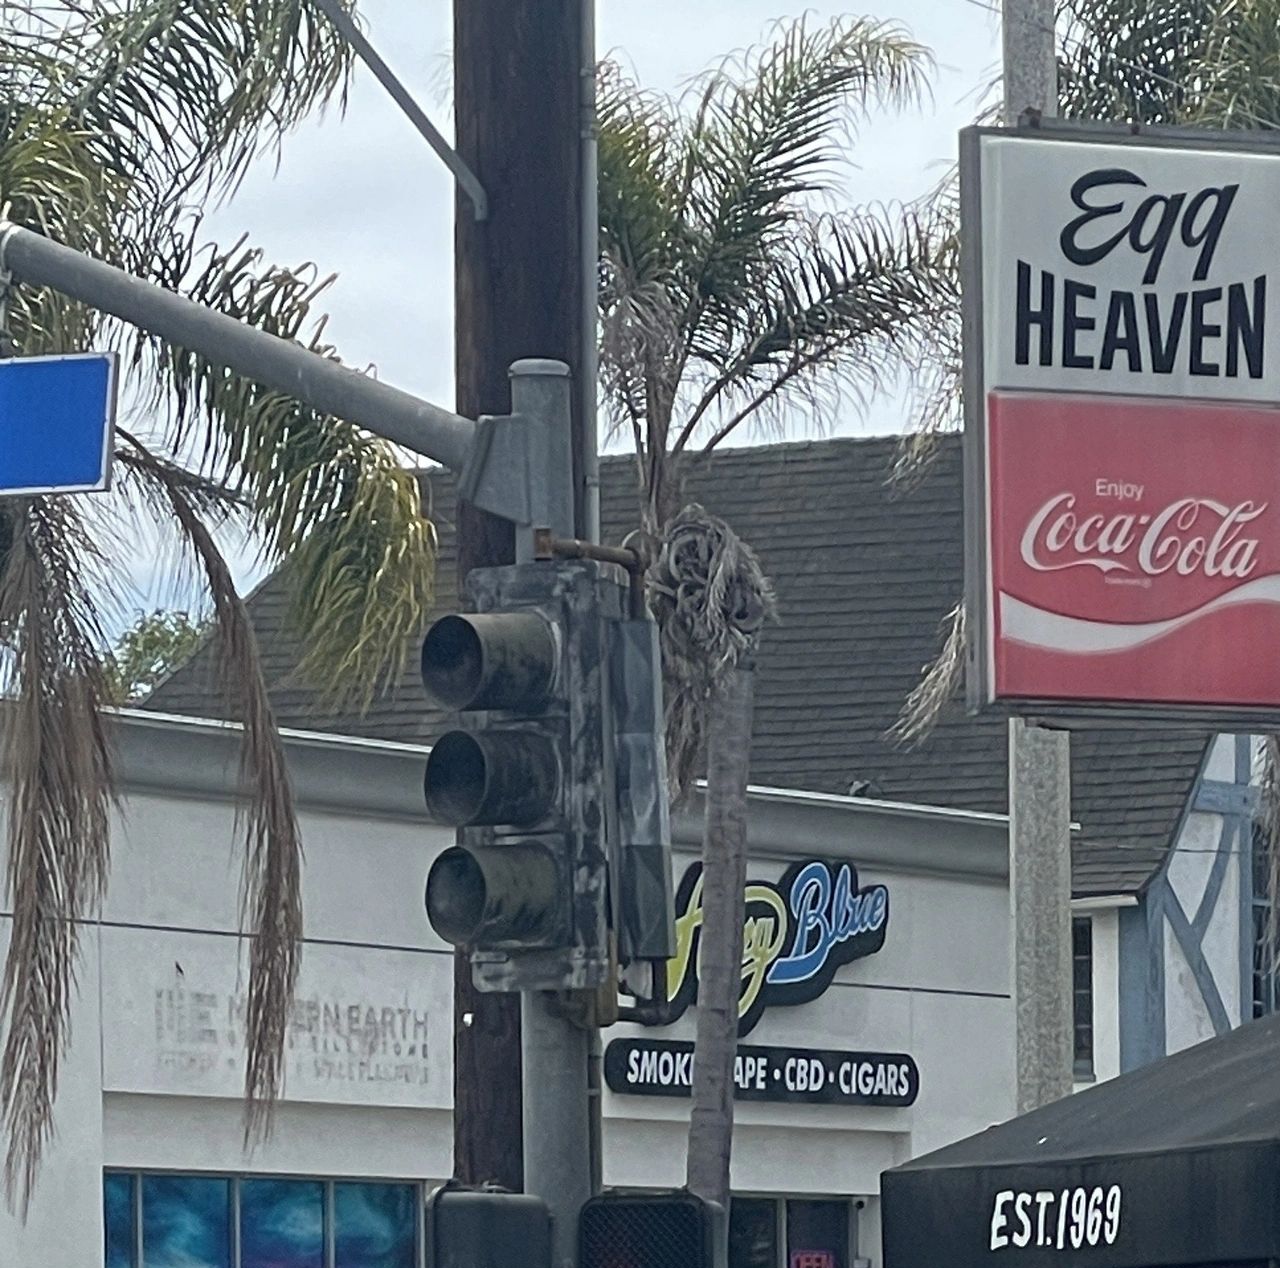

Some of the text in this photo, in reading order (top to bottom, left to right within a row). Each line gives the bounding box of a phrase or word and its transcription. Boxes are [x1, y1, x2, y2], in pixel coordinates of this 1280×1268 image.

[1060, 168, 1239, 284] Egg
[1014, 259, 1267, 379] HEAVEN
[1019, 492, 1267, 577] Coca-Cola
[1095, 478, 1144, 501] Enjoy
[766, 862, 887, 984] Blue
[626, 1049, 910, 1097] SMOK APE CBD CIGARS
